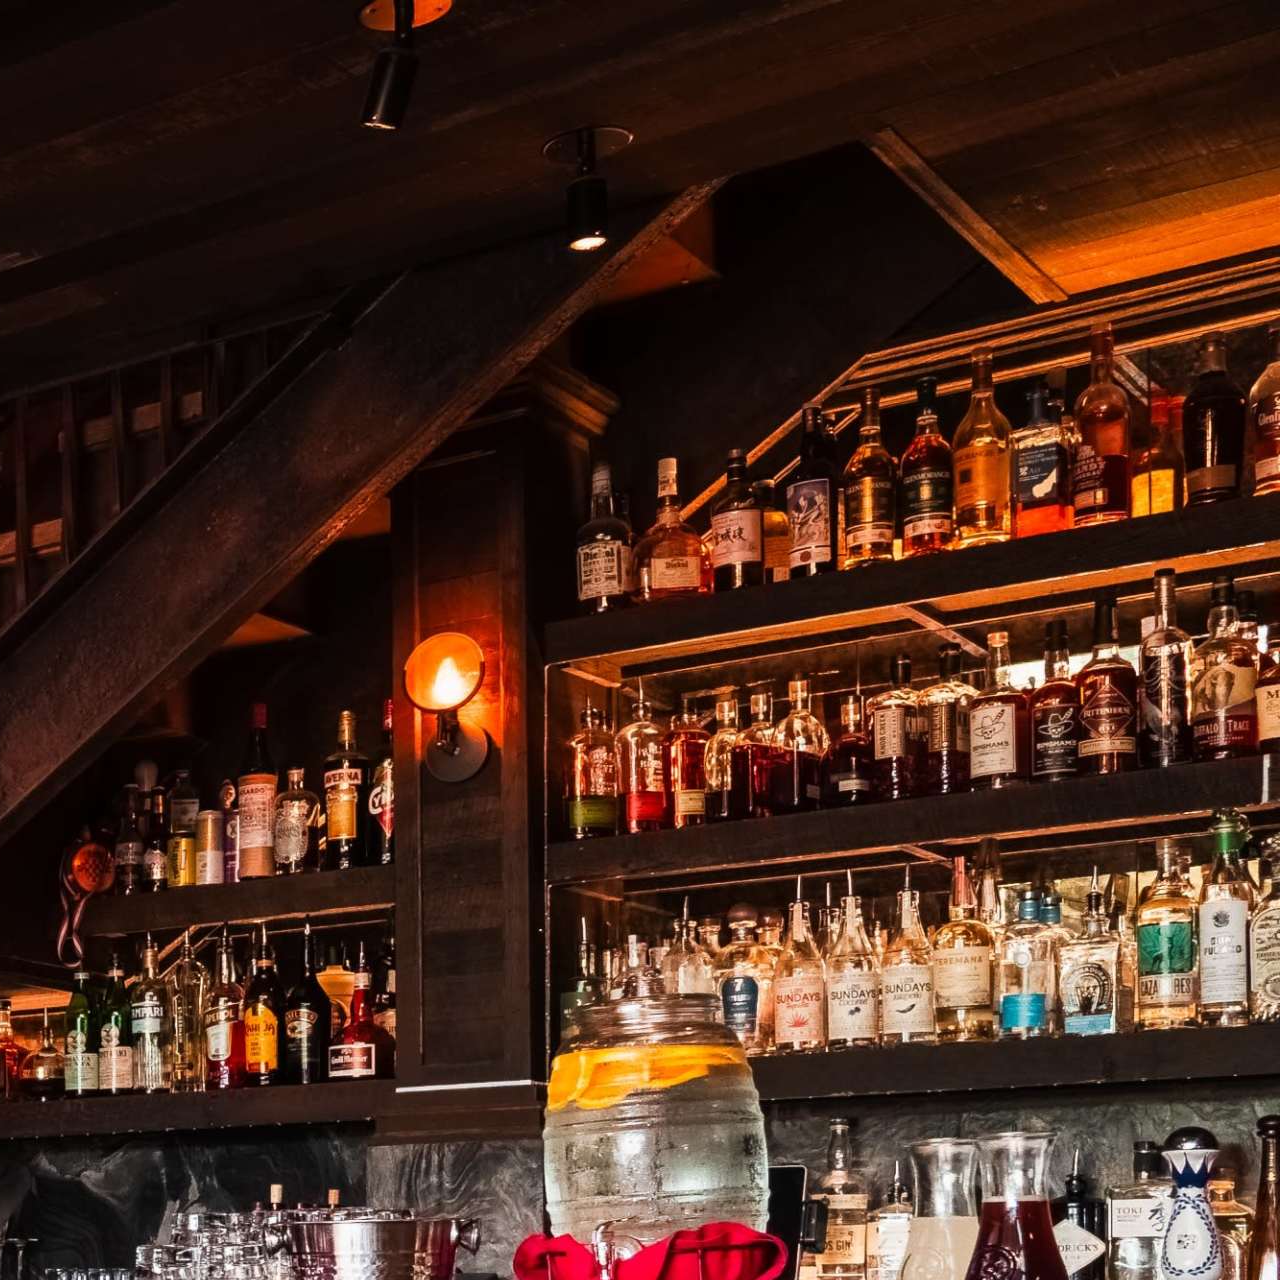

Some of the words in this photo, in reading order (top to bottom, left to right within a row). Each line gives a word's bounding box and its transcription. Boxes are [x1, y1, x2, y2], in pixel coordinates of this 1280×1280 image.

[1203, 945, 1242, 956] FULO
[885, 982, 932, 994] SUNDAYS
[1140, 977, 1192, 997] CAZARES
[776, 992, 821, 1005] SUNDAYS
[831, 989, 877, 1001] SUNDAYS
[1117, 1207, 1143, 1215] TOKI
[835, 1239, 852, 1251] GIN
